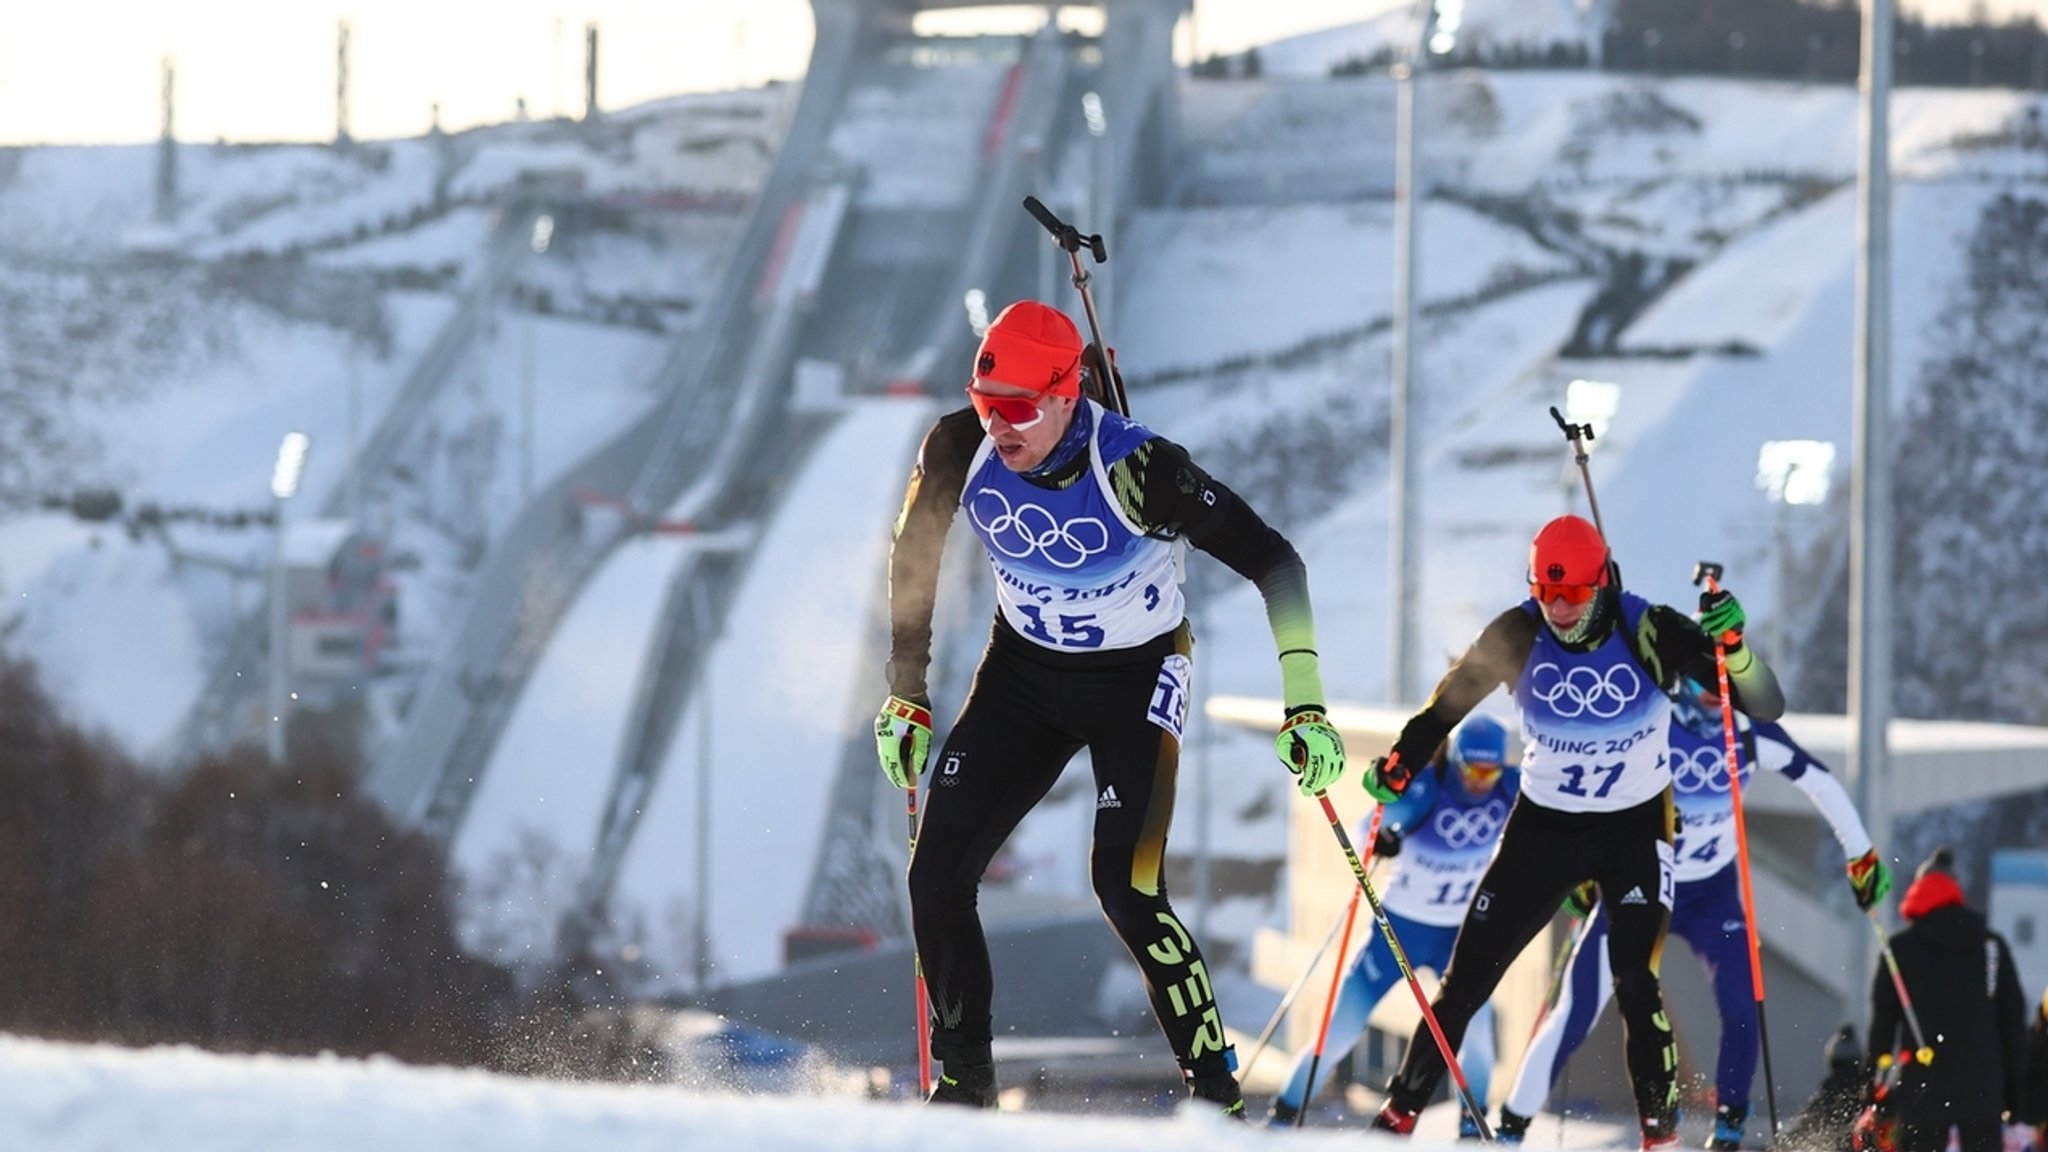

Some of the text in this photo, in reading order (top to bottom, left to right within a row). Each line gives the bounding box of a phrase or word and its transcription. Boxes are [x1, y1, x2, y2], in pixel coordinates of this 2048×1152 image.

[1016, 604, 1105, 648] 15
[1557, 761, 1626, 798] 17
[1097, 799, 1122, 810] adidas
[1427, 881, 1475, 905] 11
[1147, 912, 1225, 1060] GER
